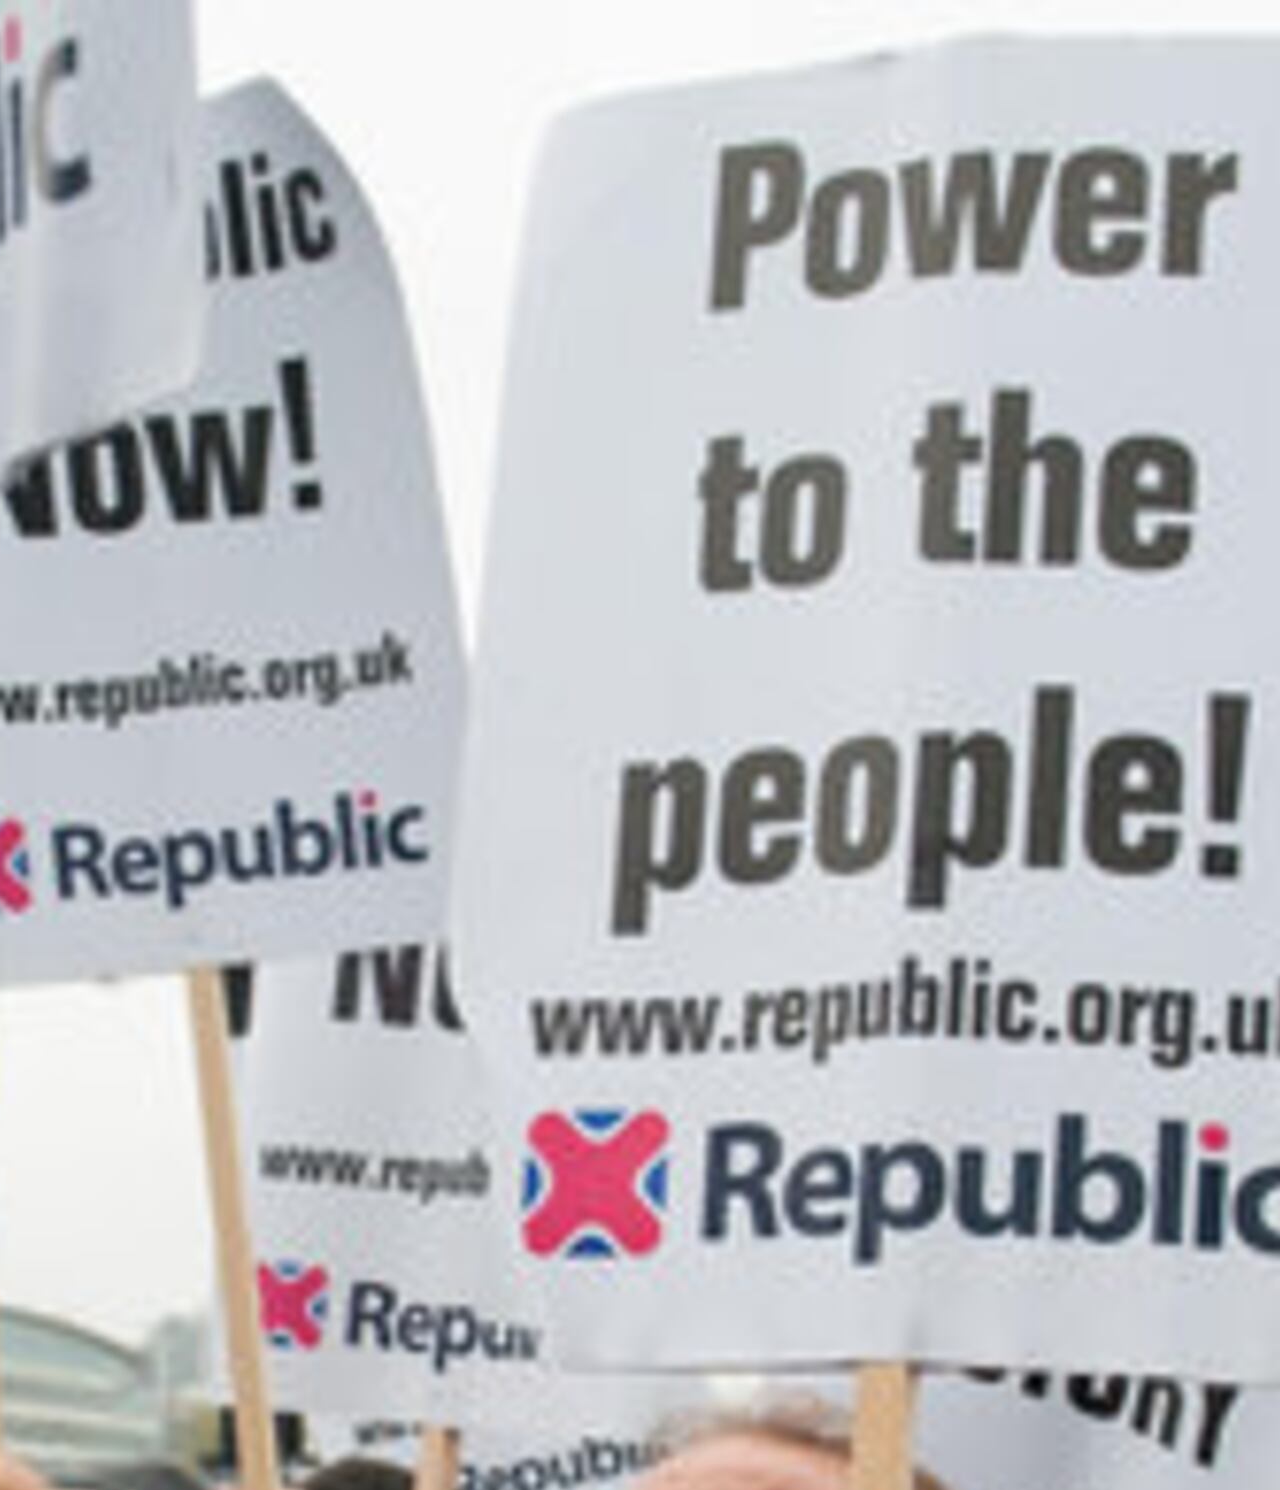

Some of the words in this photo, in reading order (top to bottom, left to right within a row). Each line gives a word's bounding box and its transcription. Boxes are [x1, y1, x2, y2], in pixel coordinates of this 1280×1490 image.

[205, 153, 337, 282] lic
[708, 139, 1239, 313] Power
[697, 436, 847, 593] to
[913, 388, 1198, 571] the
[53, 792, 428, 908] Republic
[610, 684, 1252, 937] people!
